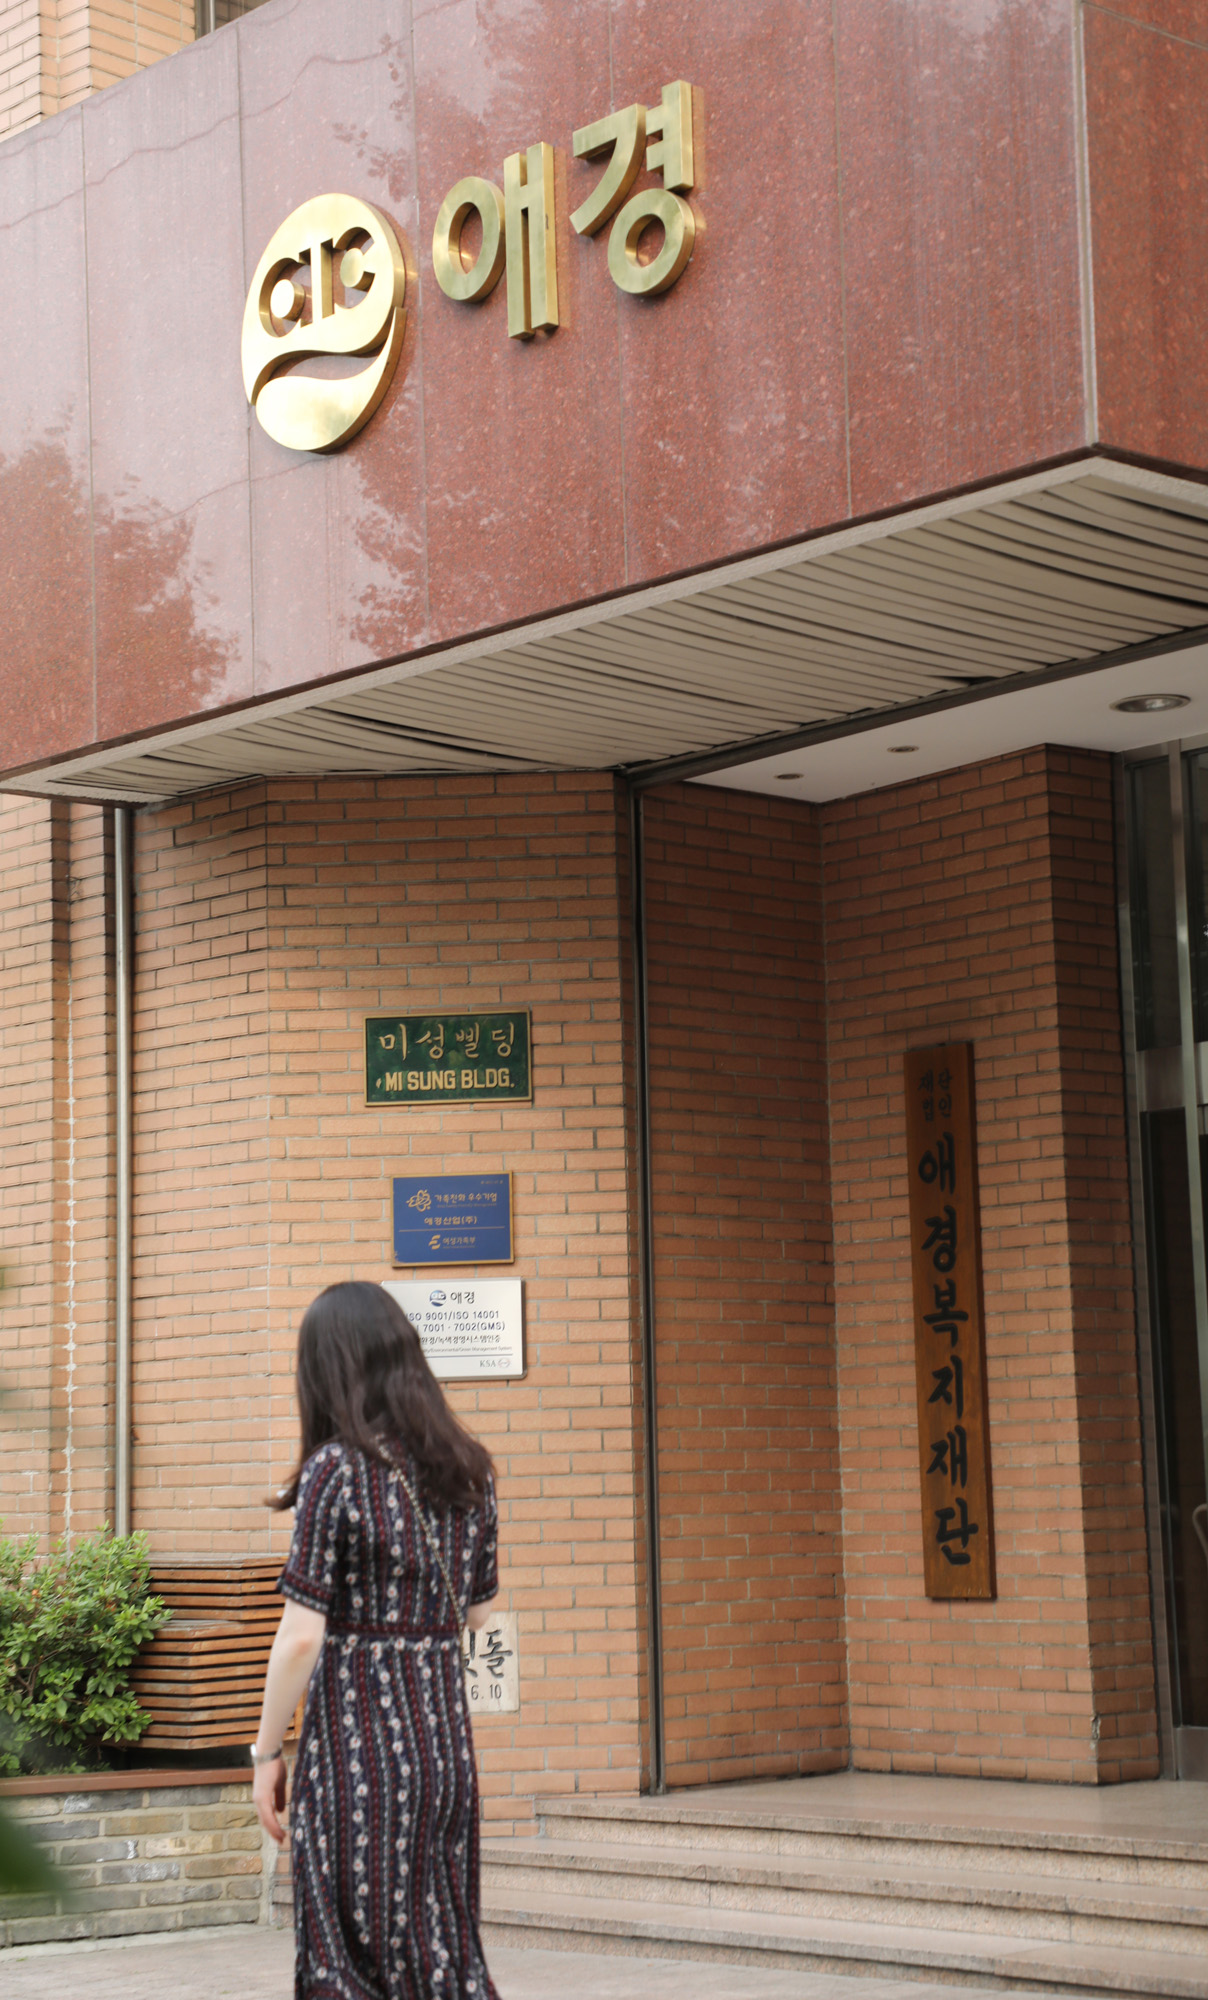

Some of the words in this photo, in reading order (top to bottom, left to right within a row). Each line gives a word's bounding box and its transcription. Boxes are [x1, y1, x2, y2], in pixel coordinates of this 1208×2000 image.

[432, 79, 696, 340] 애경
[385, 1071, 403, 1092] MI
[407, 1069, 456, 1091] SUNG
[461, 1067, 515, 1089] BLDG.
[435, 1193, 466, 1203] 가족친화
[468, 1192, 497, 1201] 우수기업
[424, 1216, 478, 1226] 애경산업(주)
[443, 1236, 475, 1245] 여성가족부
[450, 1291, 475, 1305] 애경
[425, 1311, 469, 1321] 9001/ISO
[473, 1310, 499, 1319] 14001
[423, 1323, 444, 1333] 7001
[454, 1321, 506, 1332] 7002(GMS)
[917, 1131, 979, 1566] 애경복지재단
[479, 1359, 496, 1368] KSA
